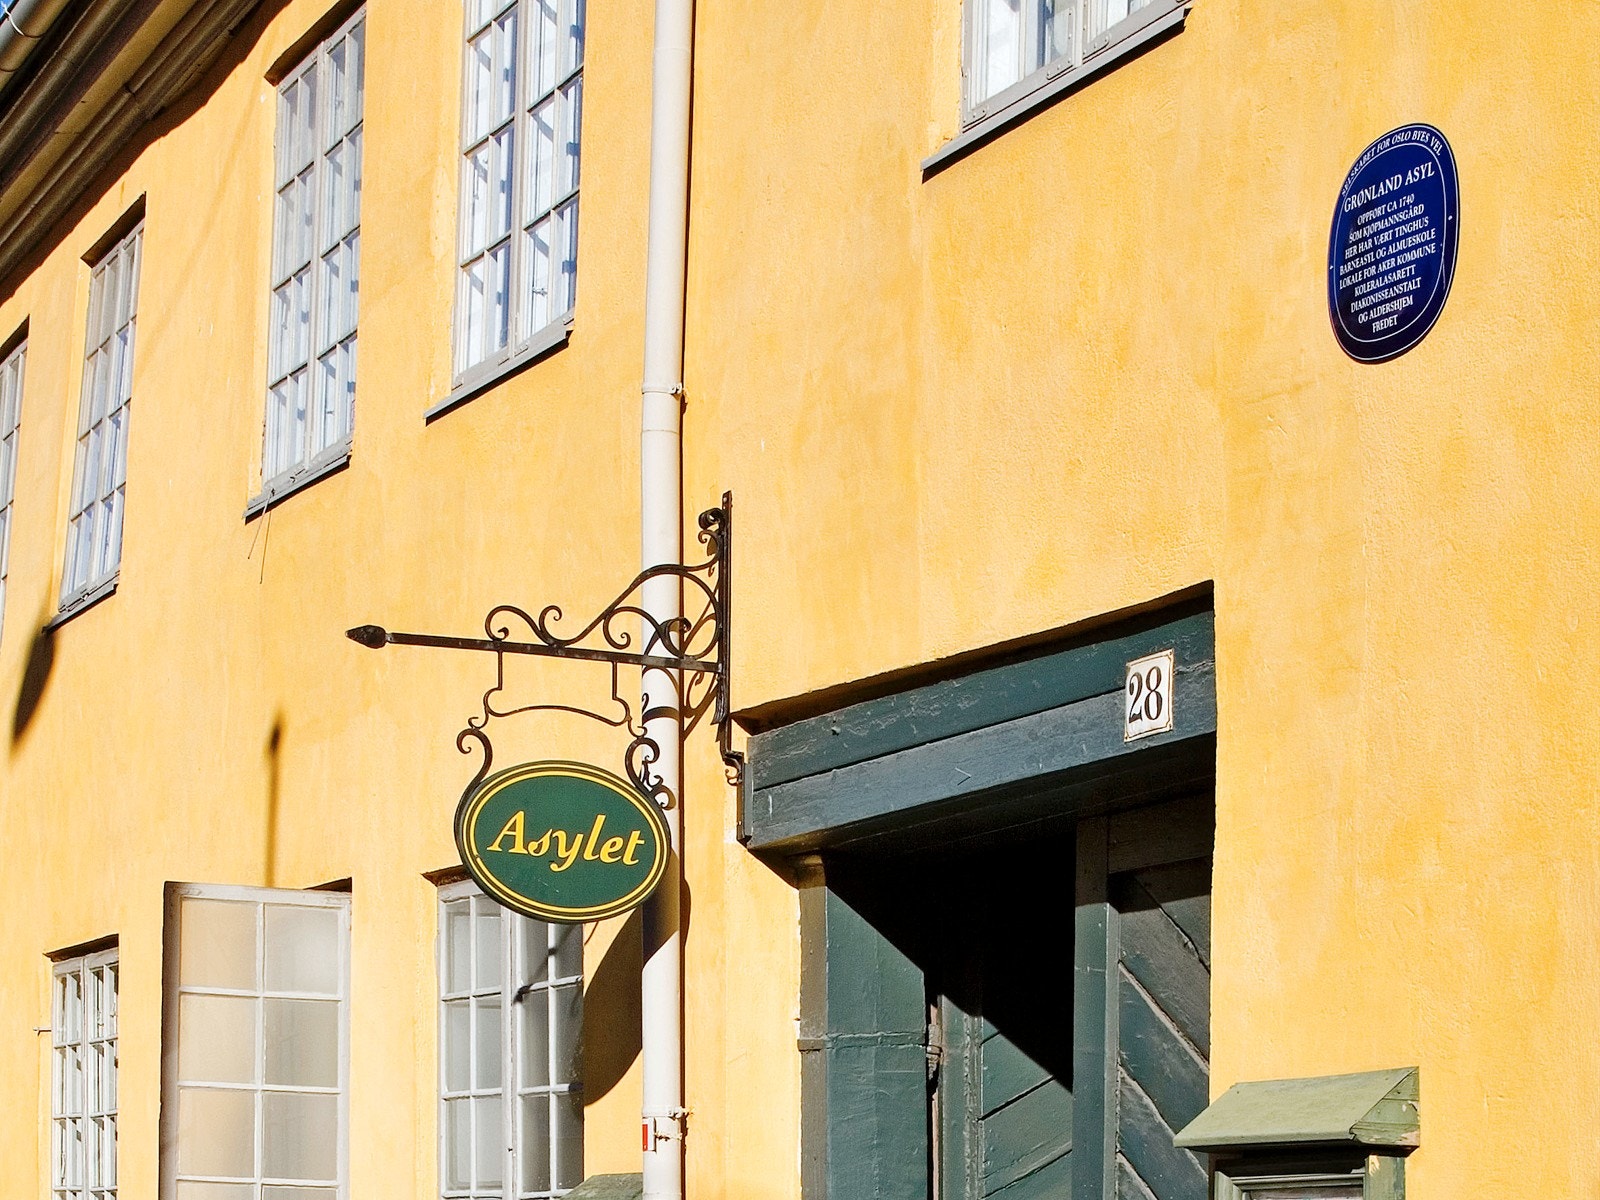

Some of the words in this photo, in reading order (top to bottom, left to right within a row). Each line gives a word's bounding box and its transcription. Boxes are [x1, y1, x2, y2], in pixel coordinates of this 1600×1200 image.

[1376, 137, 1390, 152] FOR
[1392, 131, 1411, 145] OSLO
[1431, 136, 1443, 156] VEL
[1405, 162, 1435, 186] ASYL
[1387, 200, 1398, 212] CA
[1399, 193, 1415, 208] 1740
[1339, 252, 1375, 275] BARNEASYL
[1375, 247, 1387, 259] OG
[1387, 228, 1436, 255] ALMUESKOLE
[1345, 245, 1358, 259] HER
[1358, 239, 1373, 253] HAR
[1394, 216, 1429, 238] TINGHUS
[1349, 228, 1362, 243] SOM
[1339, 271, 1363, 290] LOKALE
[1363, 265, 1377, 280] FOR
[1377, 257, 1396, 274] AKER
[1397, 243, 1436, 264] KOMMUNE
[1354, 264, 1416, 297] KOLERALASARETT
[1350, 277, 1422, 313] DIAKONISSEANSTALT
[1358, 312, 1369, 324] OG
[1369, 295, 1414, 320] ALDERSHJEM
[1372, 314, 1398, 333] FREDET
[1128, 666, 1163, 723] 28
[486, 810, 645, 872] Asylet
